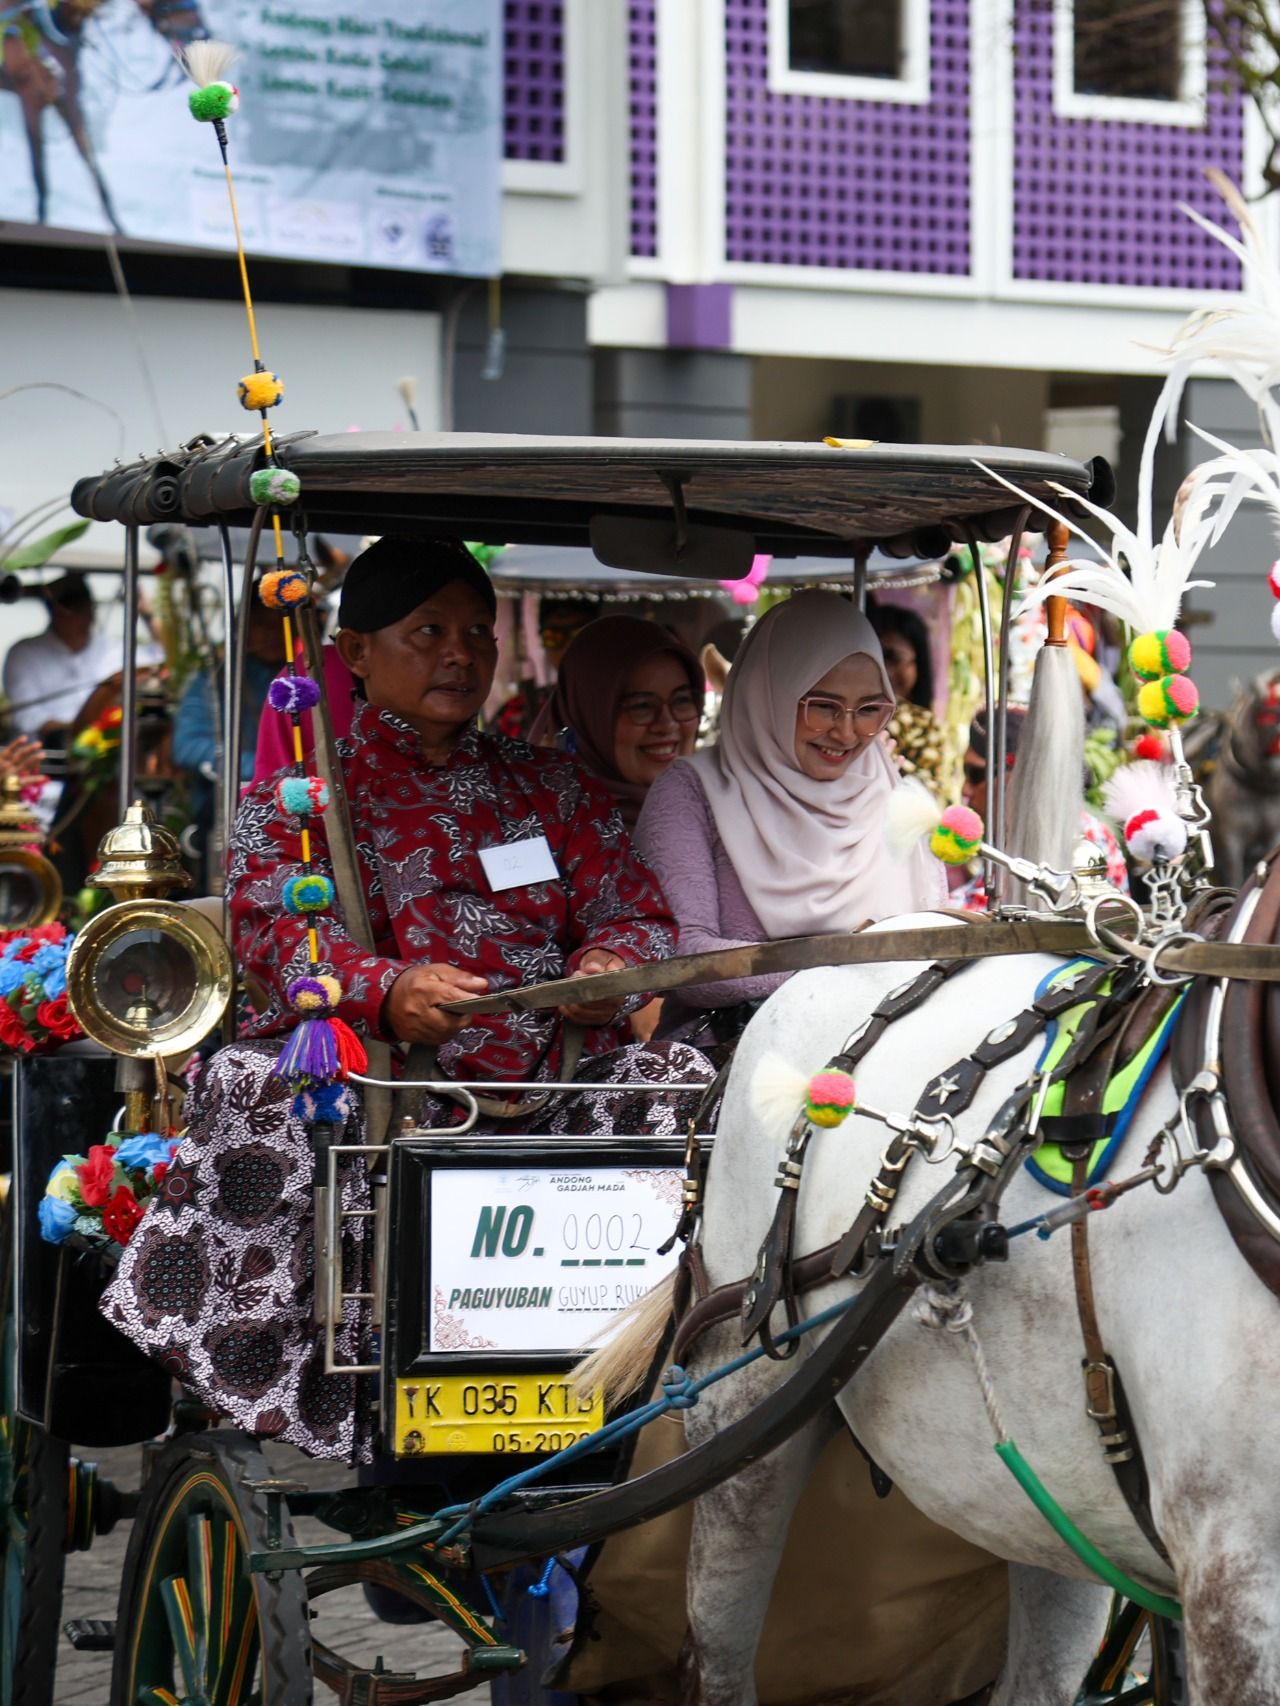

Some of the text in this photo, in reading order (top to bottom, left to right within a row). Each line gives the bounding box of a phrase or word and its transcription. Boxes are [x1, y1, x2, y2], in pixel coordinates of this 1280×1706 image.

[550, 1176, 592, 1184] ANDONG
[557, 1184, 626, 1192] GADJAH MADA
[470, 1205, 650, 1258] NO. 0002
[448, 1286, 553, 1310] PAGUYUBAN
[559, 1285, 608, 1307] GUYUP
[403, 1385, 442, 1418] YK
[463, 1384, 518, 1416] 035
